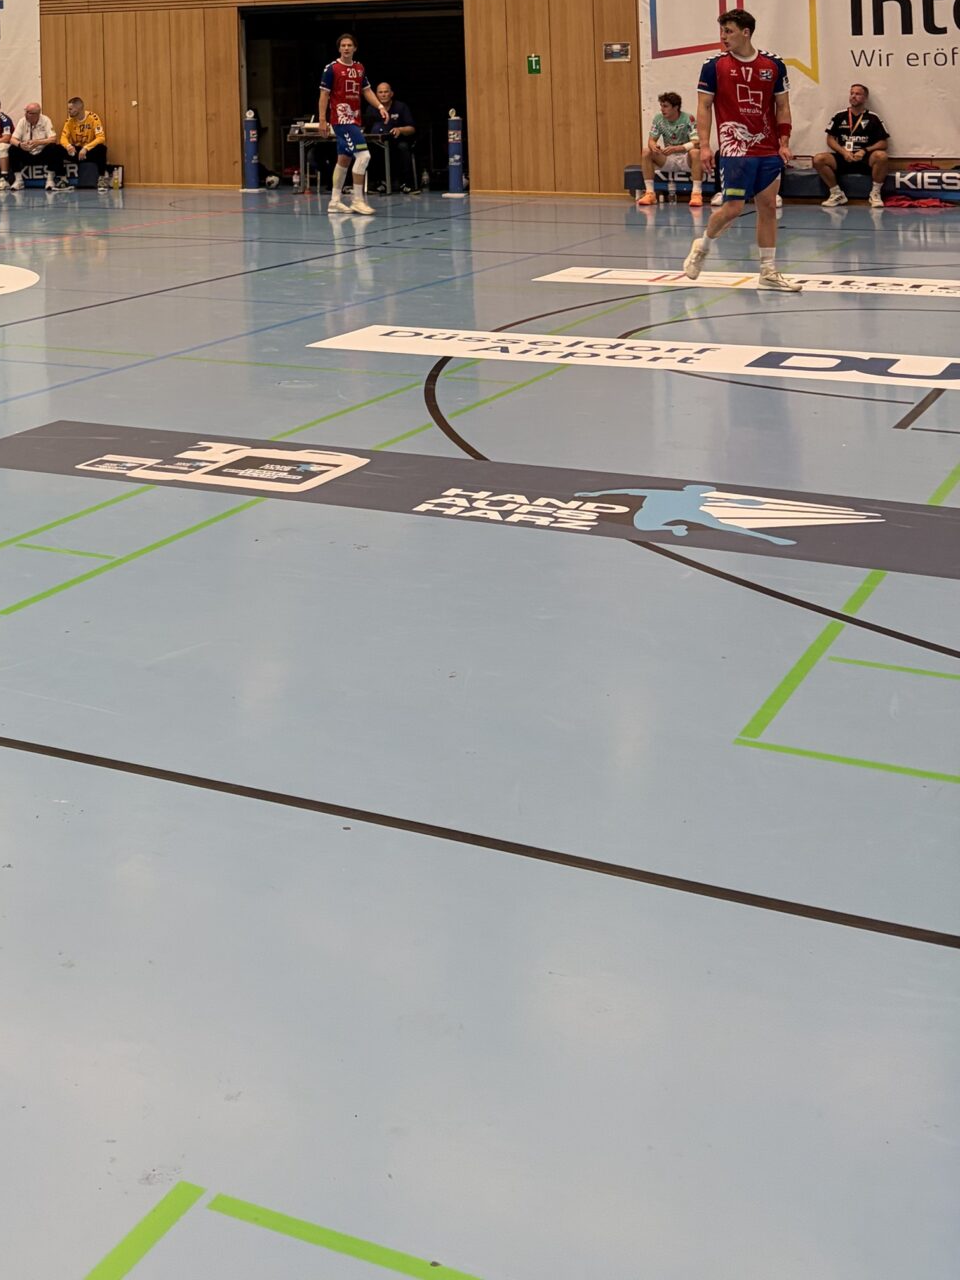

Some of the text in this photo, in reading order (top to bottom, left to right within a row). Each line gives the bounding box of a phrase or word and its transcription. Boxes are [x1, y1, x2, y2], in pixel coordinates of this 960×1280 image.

[850, 48, 894, 67] Wir
[347, 68, 357, 78] 20
[740, 66, 753, 82] 17
[21, 164, 79, 180] KIESR
[378, 330, 722, 355] Düsseldorf
[468, 345, 702, 365] Airport
[425, 497, 600, 520] AUFS
[441, 487, 630, 513] HAND
[412, 503, 599, 531] HARZ
